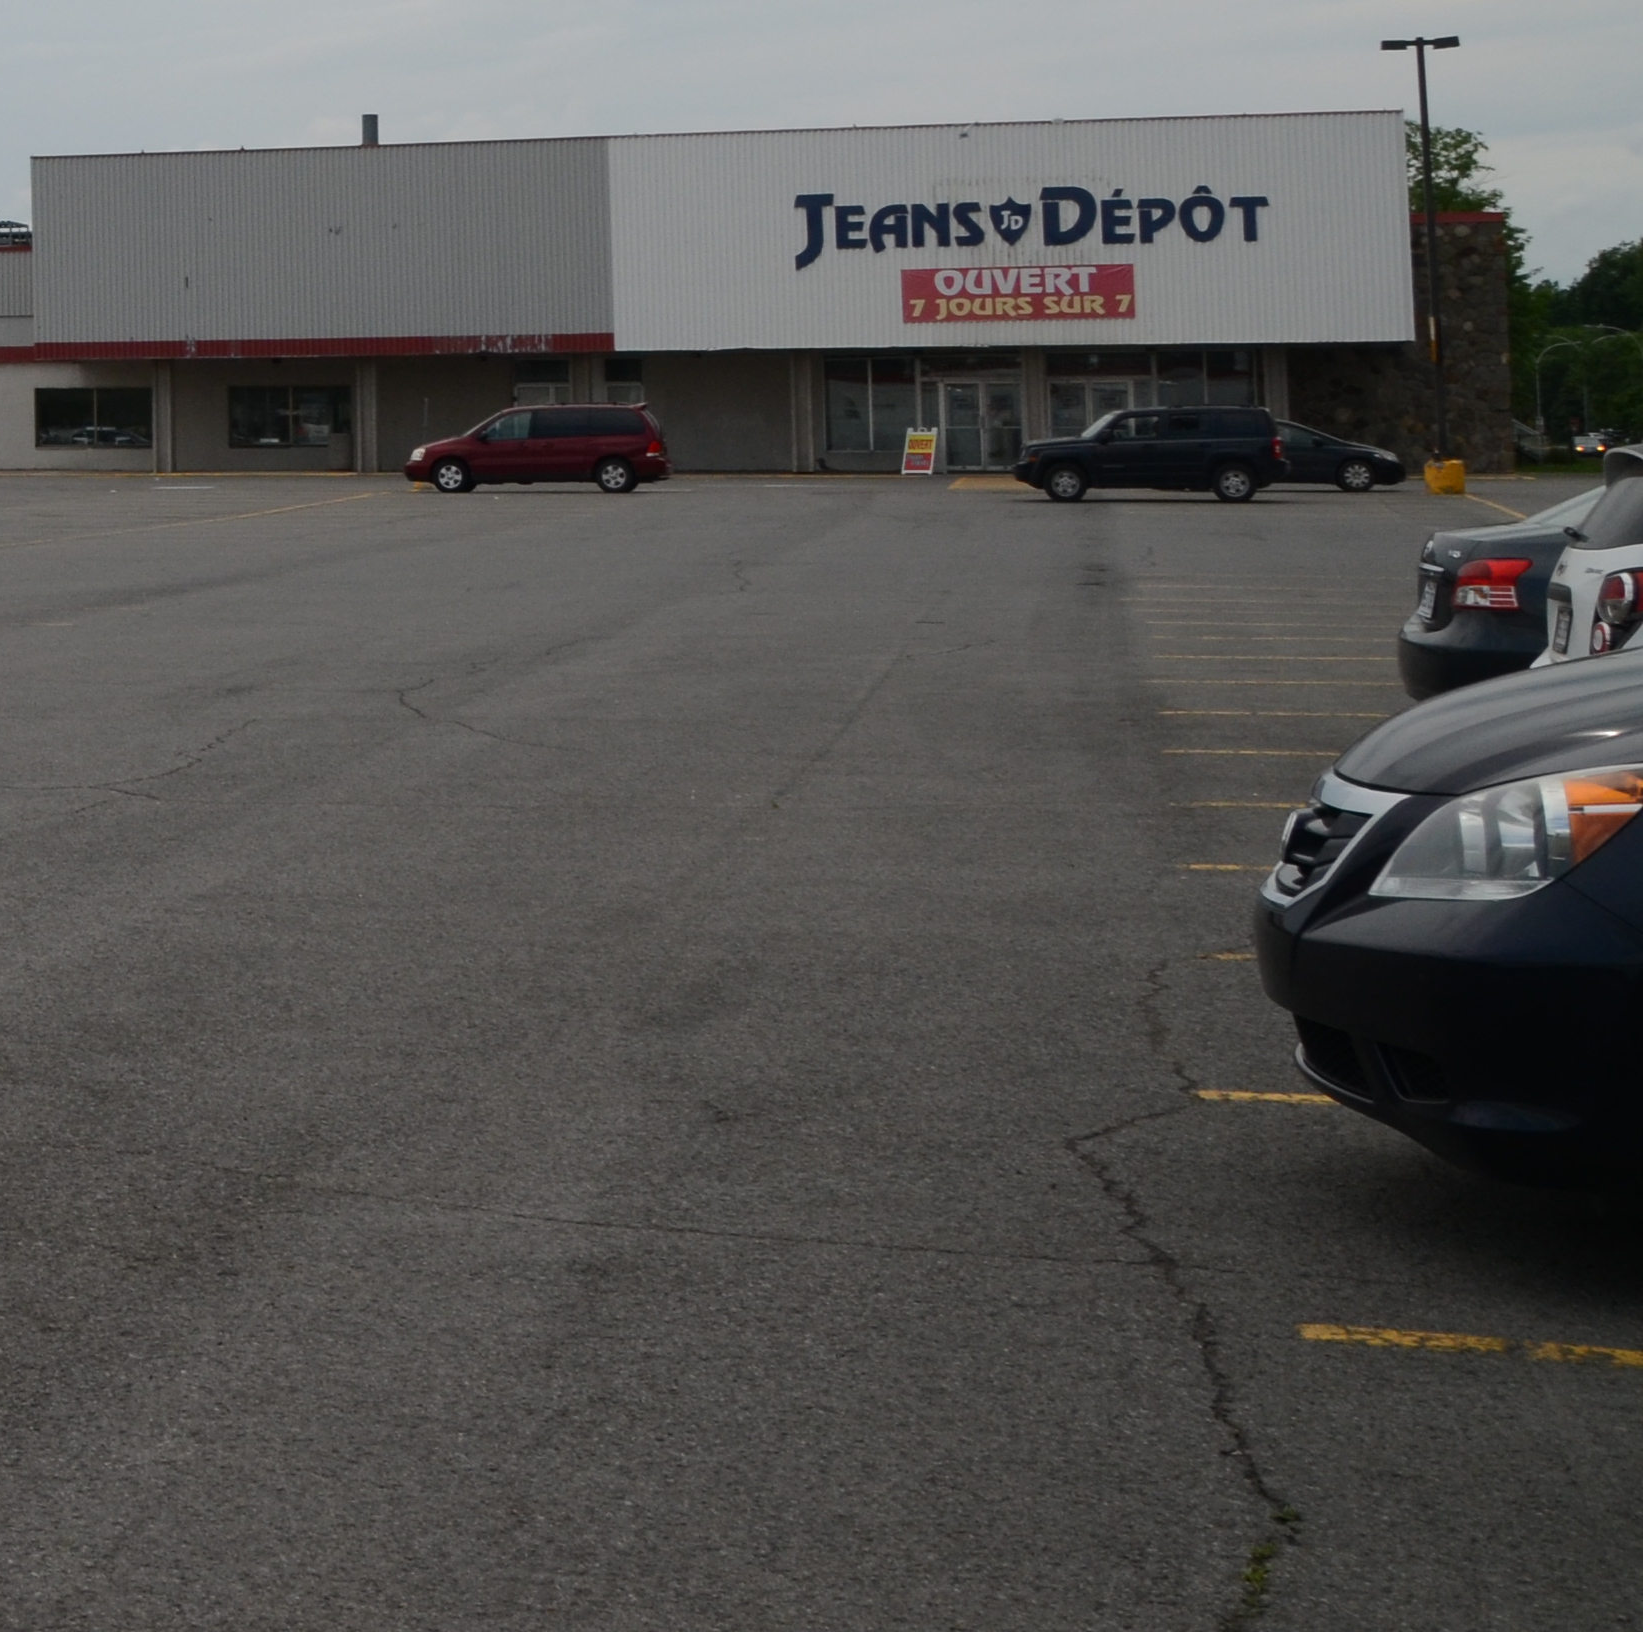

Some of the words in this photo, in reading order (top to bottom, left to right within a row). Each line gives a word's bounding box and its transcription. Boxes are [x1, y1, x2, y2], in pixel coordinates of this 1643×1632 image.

[1001, 210, 1024, 230] JD
[1039, 185, 1269, 246] DÉPÔT
[934, 266, 1097, 296] OUVERT
[909, 299, 926, 317] 7
[935, 296, 1033, 320] JOURS
[1042, 295, 1106, 315] SUR
[1115, 294, 1132, 313] 7
